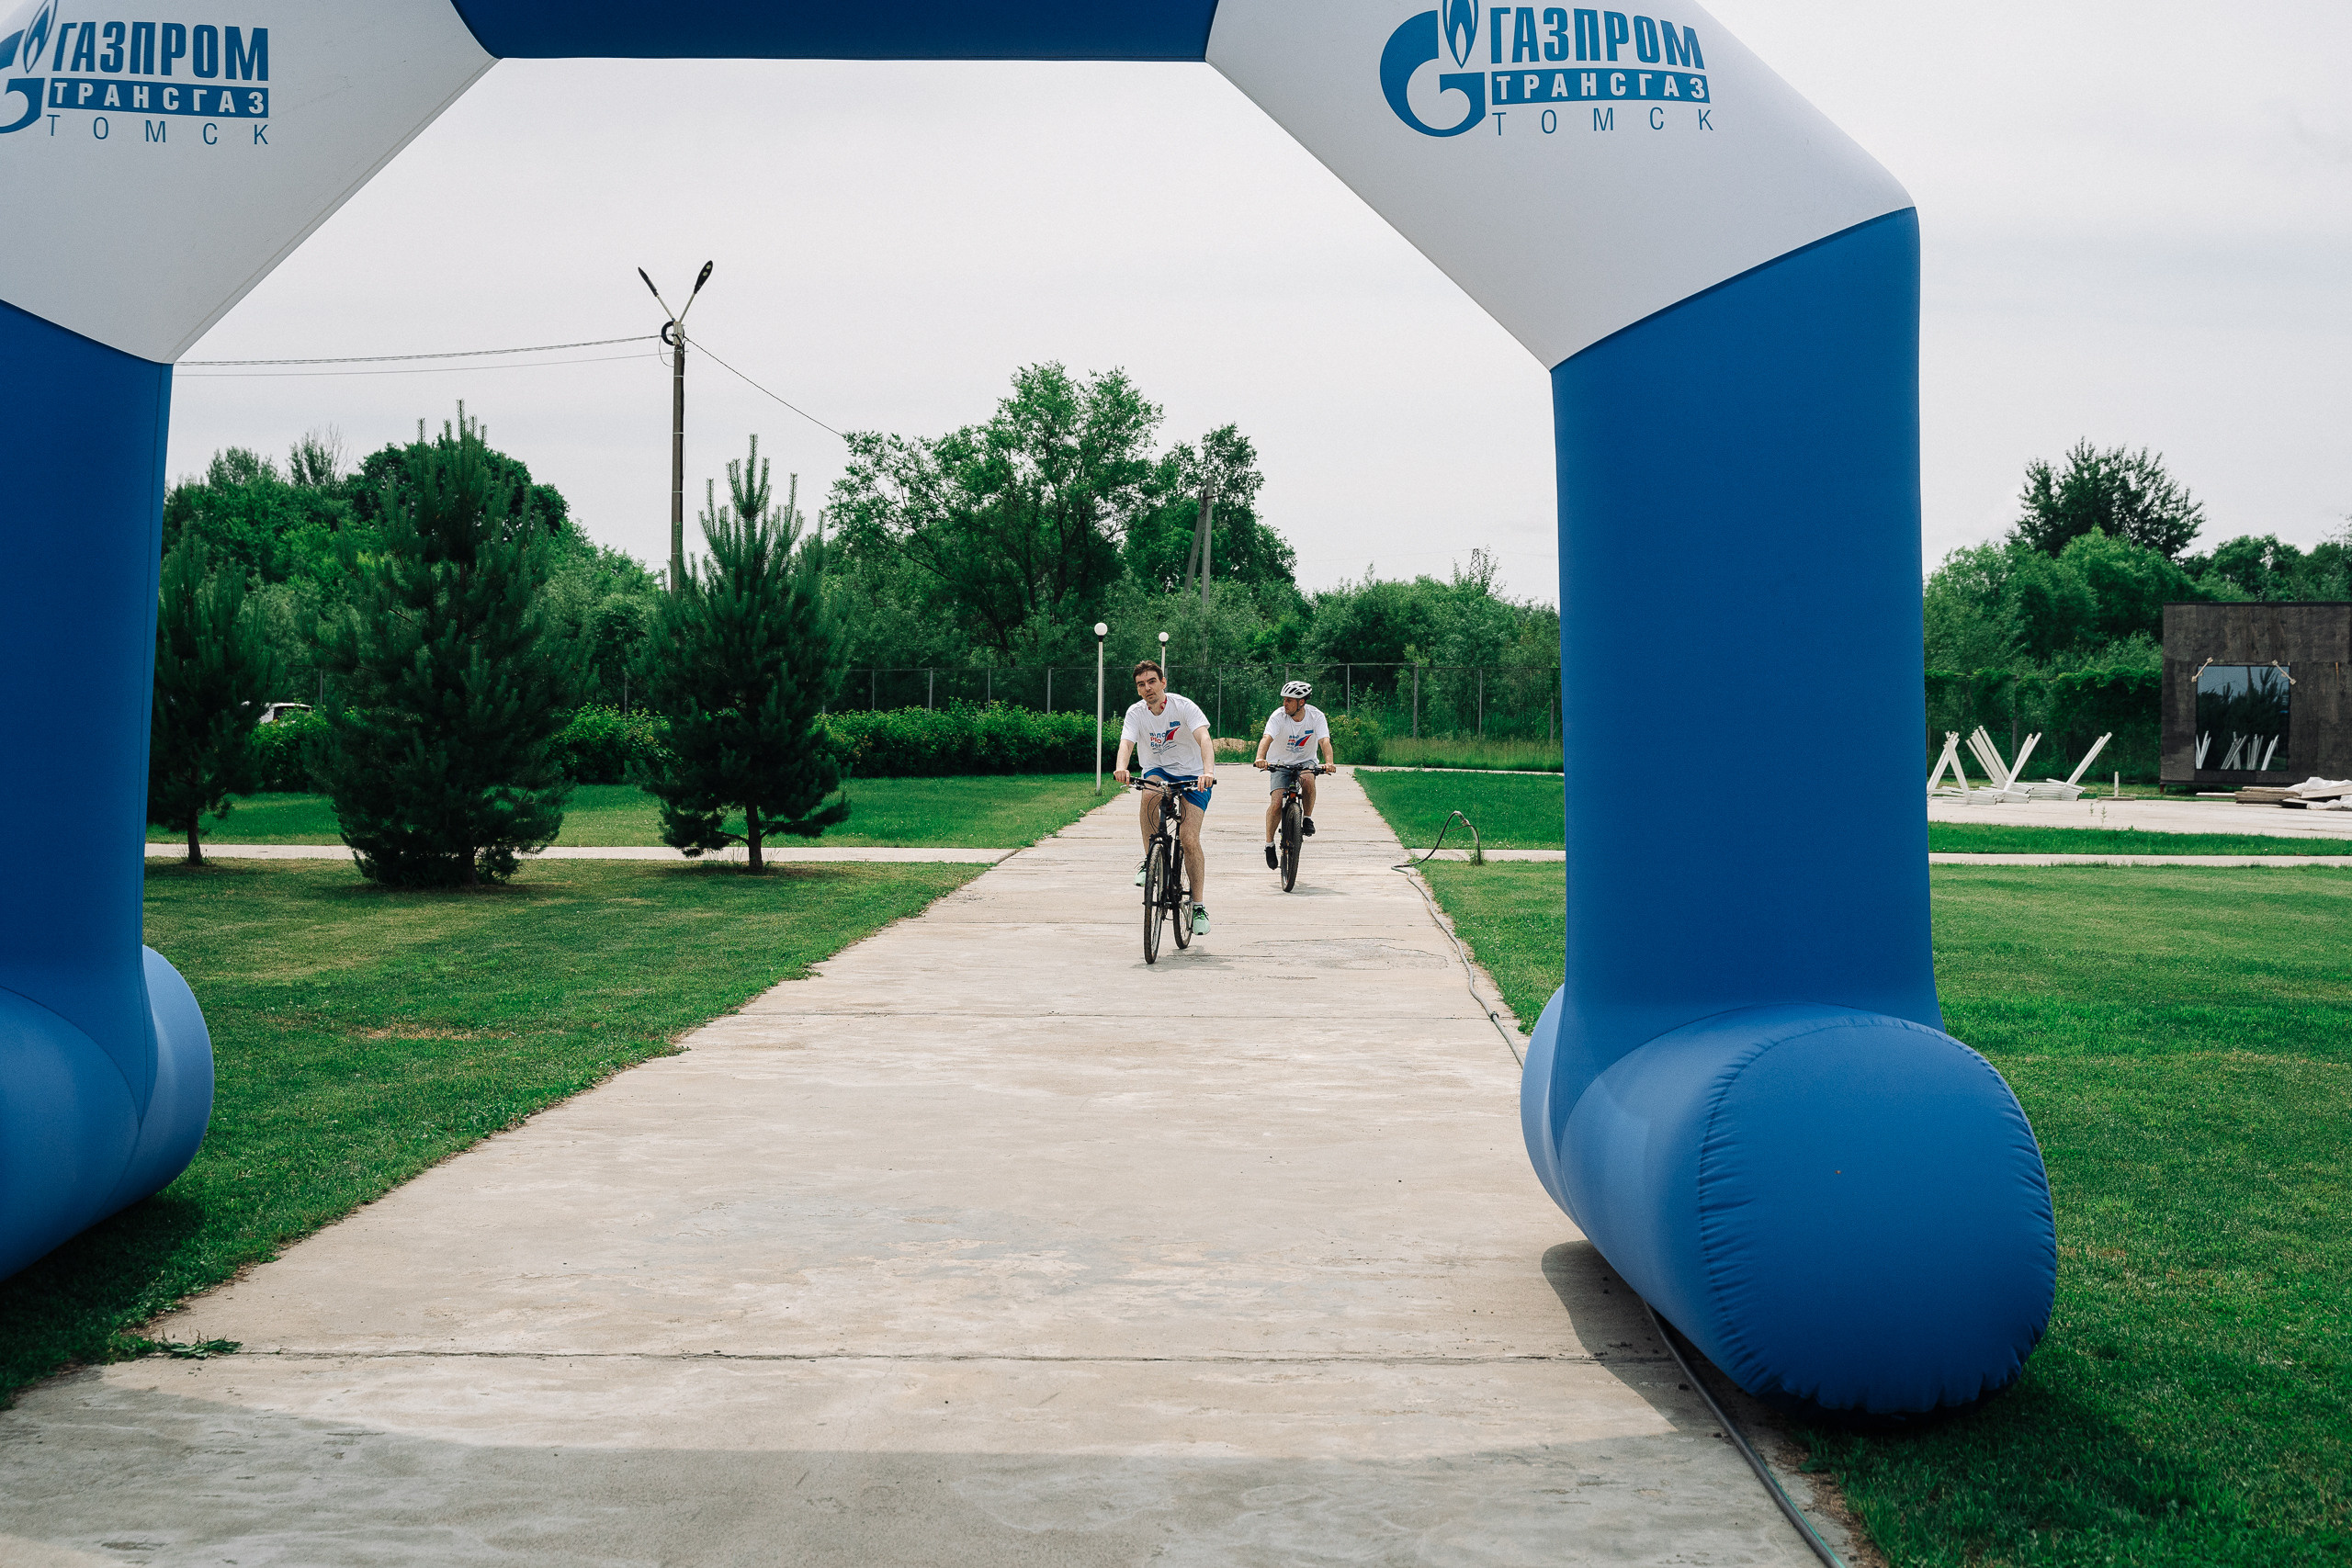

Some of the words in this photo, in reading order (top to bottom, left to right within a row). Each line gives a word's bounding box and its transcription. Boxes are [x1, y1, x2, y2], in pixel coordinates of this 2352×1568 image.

[52, 21, 269, 82] ГАЗПРОМ
[1489, 6, 1705, 70] ГАЗПРОМ
[53, 82, 265, 115] ТРАНСГАЗ
[1496, 73, 1705, 100] ТРАНСГАЗ
[47, 114, 269, 145] ТОМСК
[1491, 107, 1713, 136] ТОМСК
